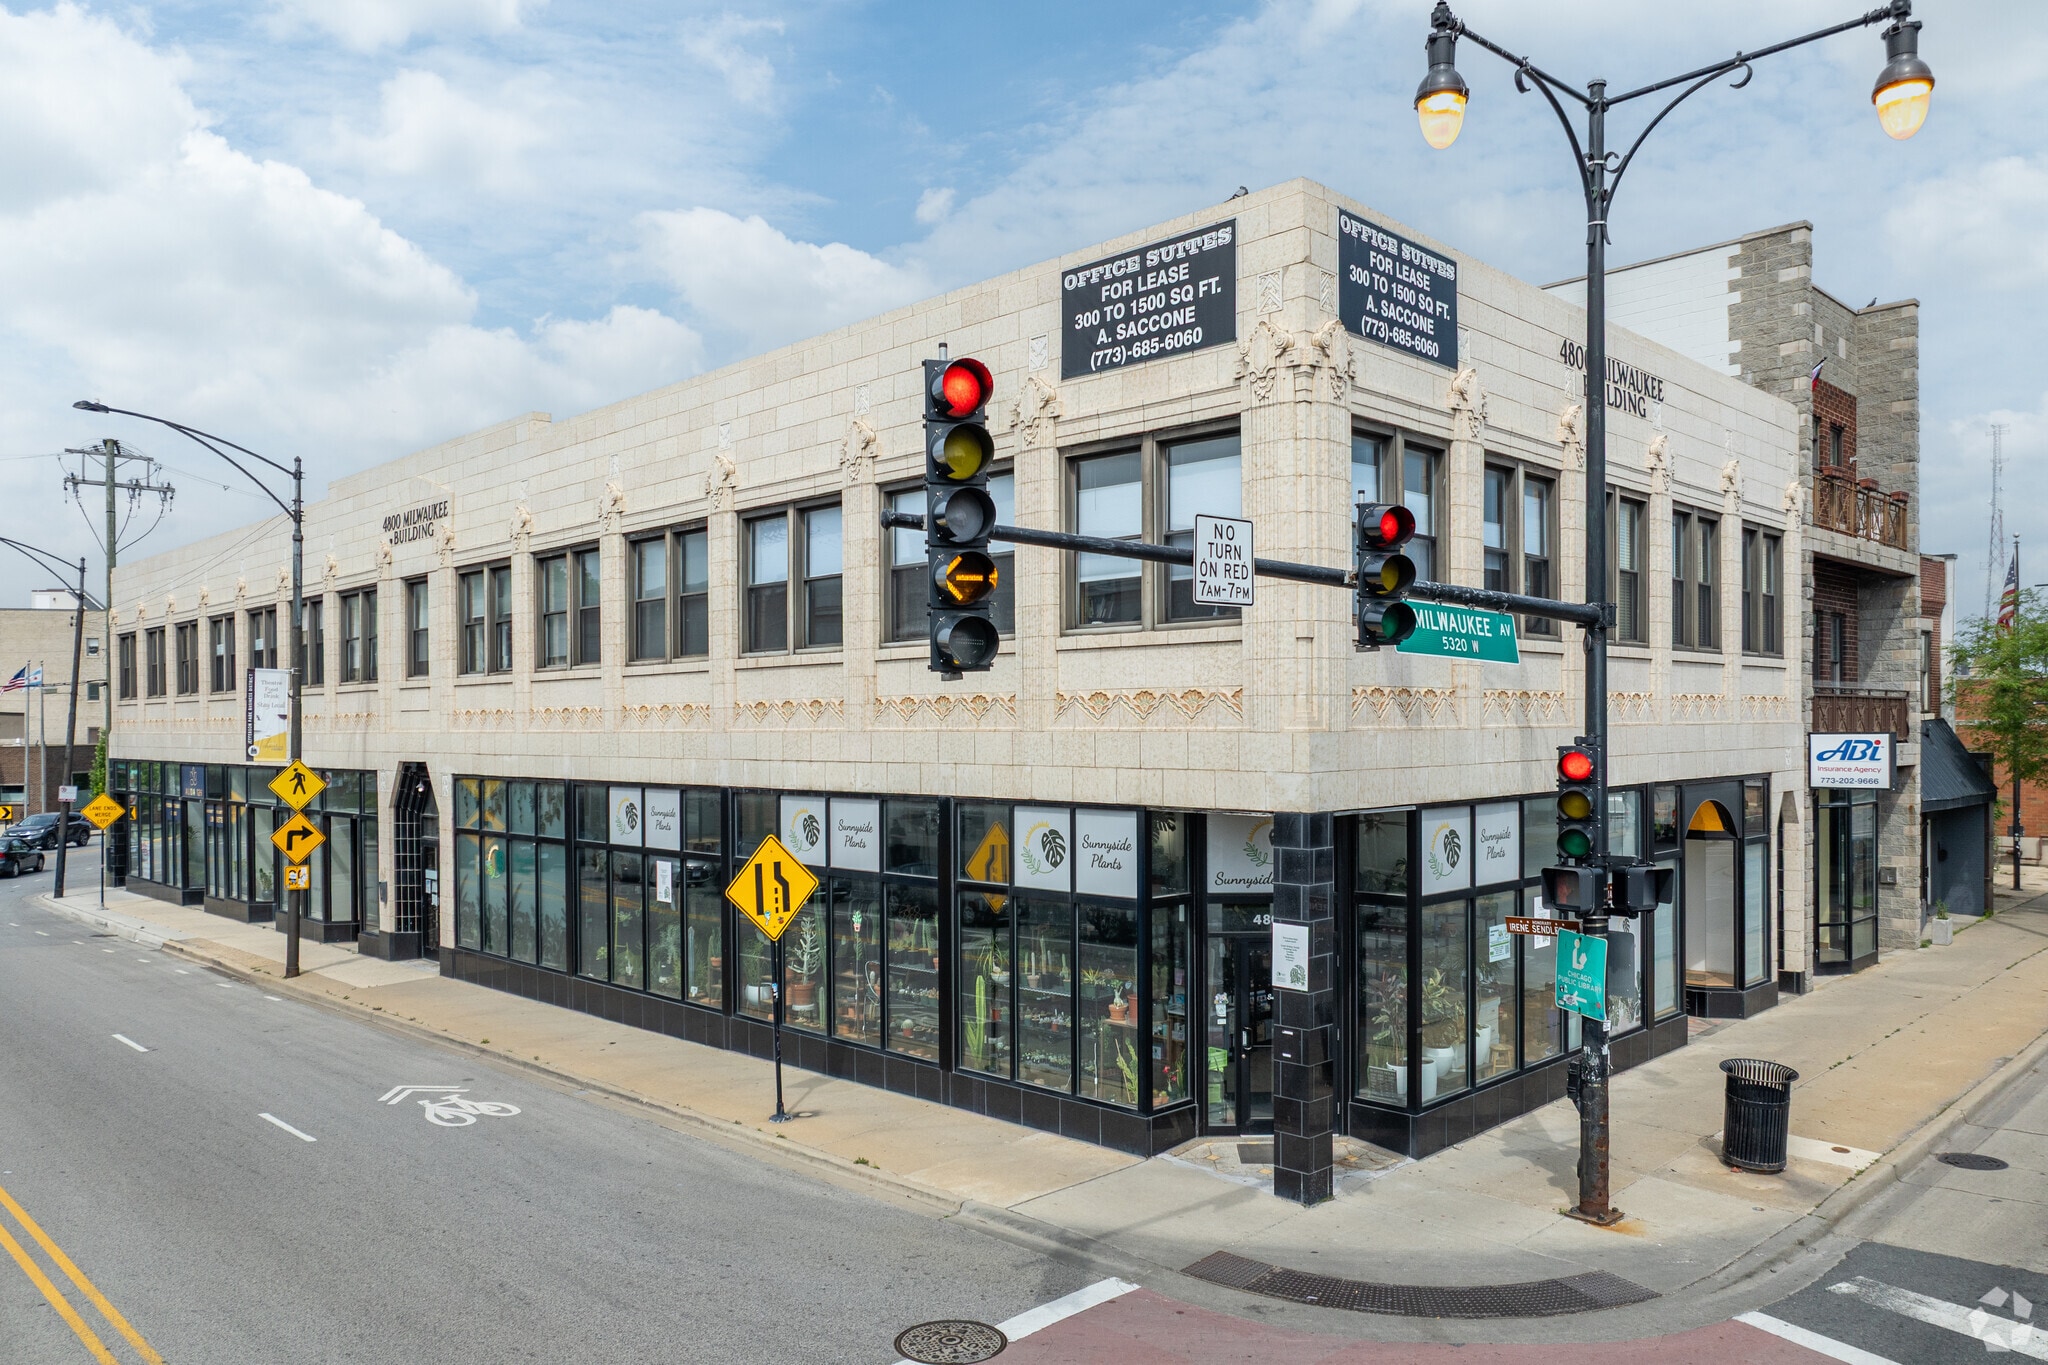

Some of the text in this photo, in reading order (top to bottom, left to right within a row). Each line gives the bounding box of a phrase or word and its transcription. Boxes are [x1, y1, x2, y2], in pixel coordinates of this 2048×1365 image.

[1340, 214, 1455, 281] OFFICE SUITES
[1064, 227, 1232, 290] OFFICE SUITES
[1369, 251, 1431, 292] FOR LEASE
[1101, 263, 1190, 302] FOR LEASE
[1349, 264, 1450, 320] 300 TO 1500 SQ FT.
[1074, 277, 1222, 329] 300 TO 1500 SQ FT.
[1366, 295, 1434, 335] A. SACCONE
[1096, 306, 1196, 345] A. SACCONE
[1361, 315, 1439, 358] (773)-685-6060
[1090, 327, 1203, 371] (773)-685-6060
[1560, 339, 1664, 402] 480 ILWAUKEE
[383, 501, 448, 532] 4800 MILWAUKEE
[394, 522, 434, 545] BUILDING
[1214, 523, 1235, 541] NO
[1208, 542, 1241, 560] TURN
[1200, 560, 1249, 580] ON RED
[1199, 580, 1250, 599] 7AM-7PM
[1414, 608, 1511, 637] MILWAUKEE AV
[1442, 636, 1479, 653] 5320 W
[1817, 765, 1852, 773] Insurance
[1820, 777, 1879, 785] 773-202-9666
[651, 805, 676, 820] Sunnyside
[655, 819, 671, 831] Plants
[838, 818, 873, 835] Sunnyside
[844, 834, 867, 849] Plants
[1082, 833, 1133, 854] Sunnyside
[1480, 826, 1512, 845] Sunnyside
[1090, 853, 1122, 870] Plants
[1486, 846, 1506, 861] Plants
[1214, 871, 1274, 889] Sunnysid
[1509, 922, 1530, 933] IRENE
[1558, 974, 1602, 993] PUBLIC LIBRARY
[1567, 970, 1592, 983] CHICAGO
